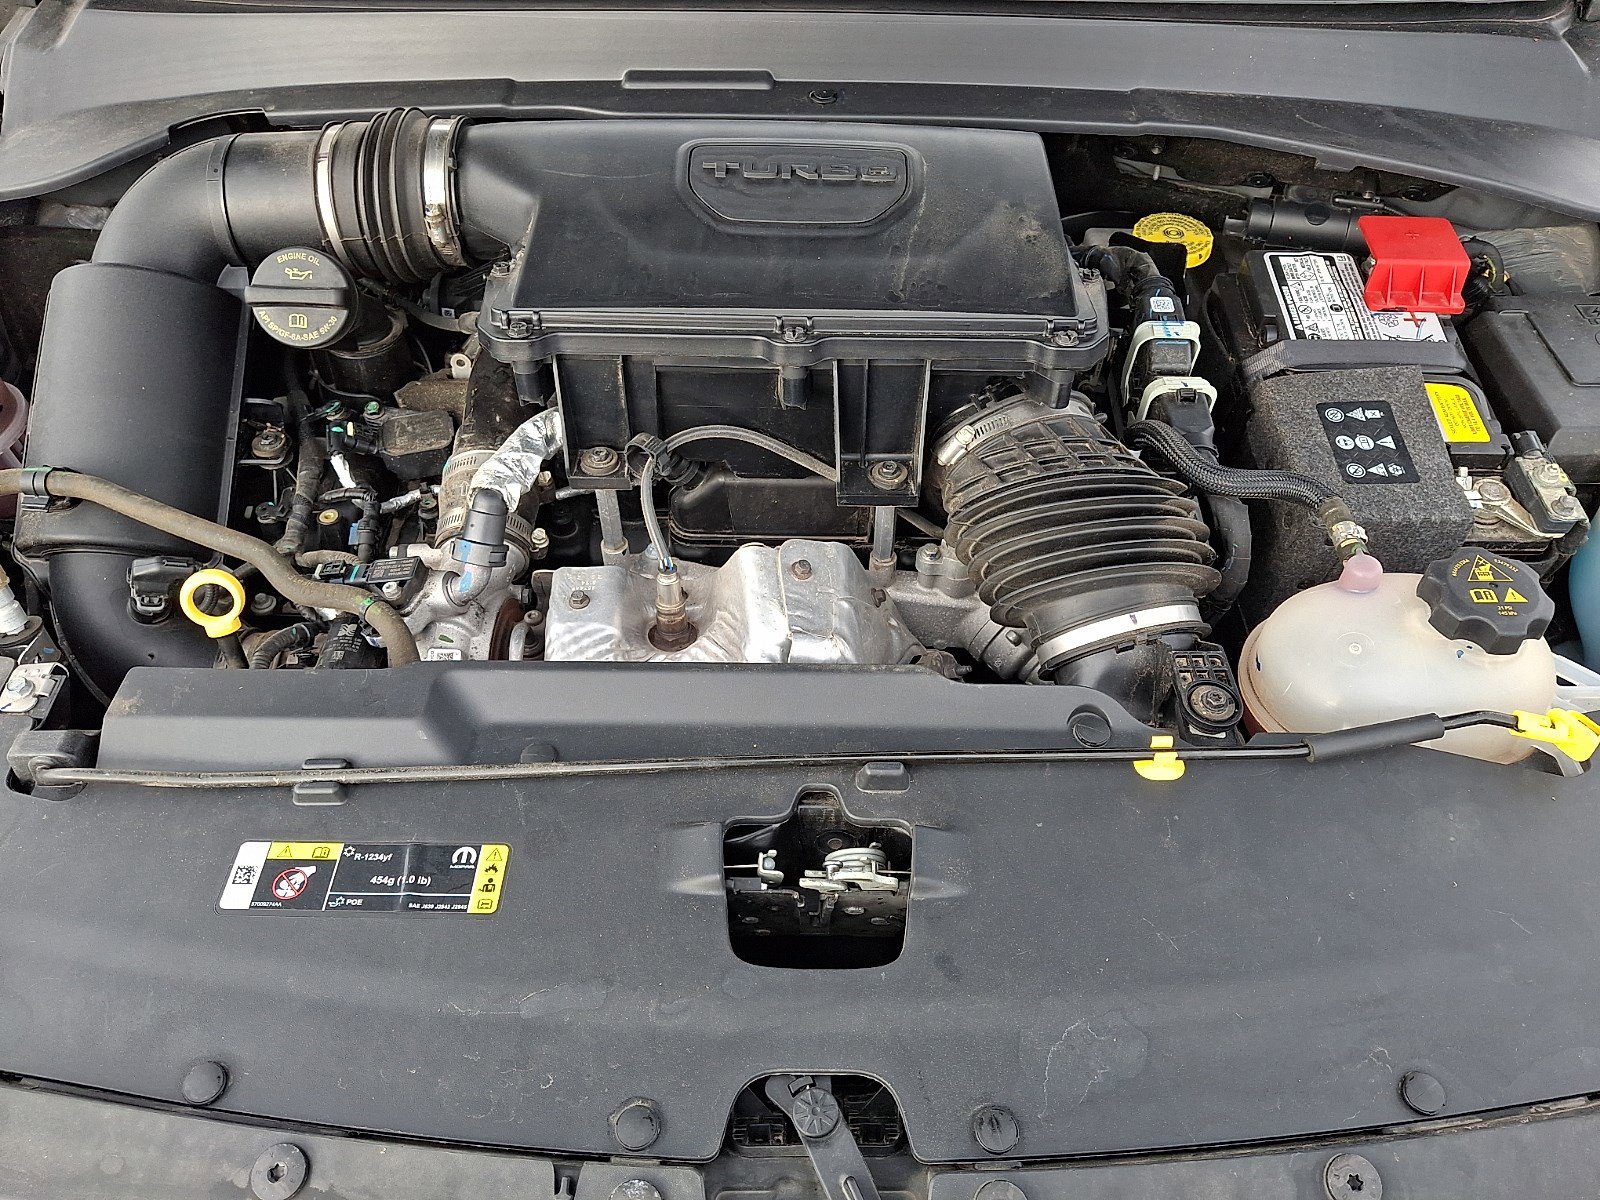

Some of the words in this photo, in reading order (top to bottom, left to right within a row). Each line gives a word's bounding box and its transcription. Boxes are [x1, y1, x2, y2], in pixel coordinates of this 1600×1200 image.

[702, 160, 897, 182] TURBO
[276, 252, 307, 264] ENGINE
[308, 255, 321, 267] OIL
[258, 310, 269, 324] API
[353, 853, 393, 863] R-1234yf
[369, 875, 396, 886] 454g
[396, 875, 415, 886] (1.0
[416, 875, 432, 887] lb)
[345, 898, 364, 906] POE
